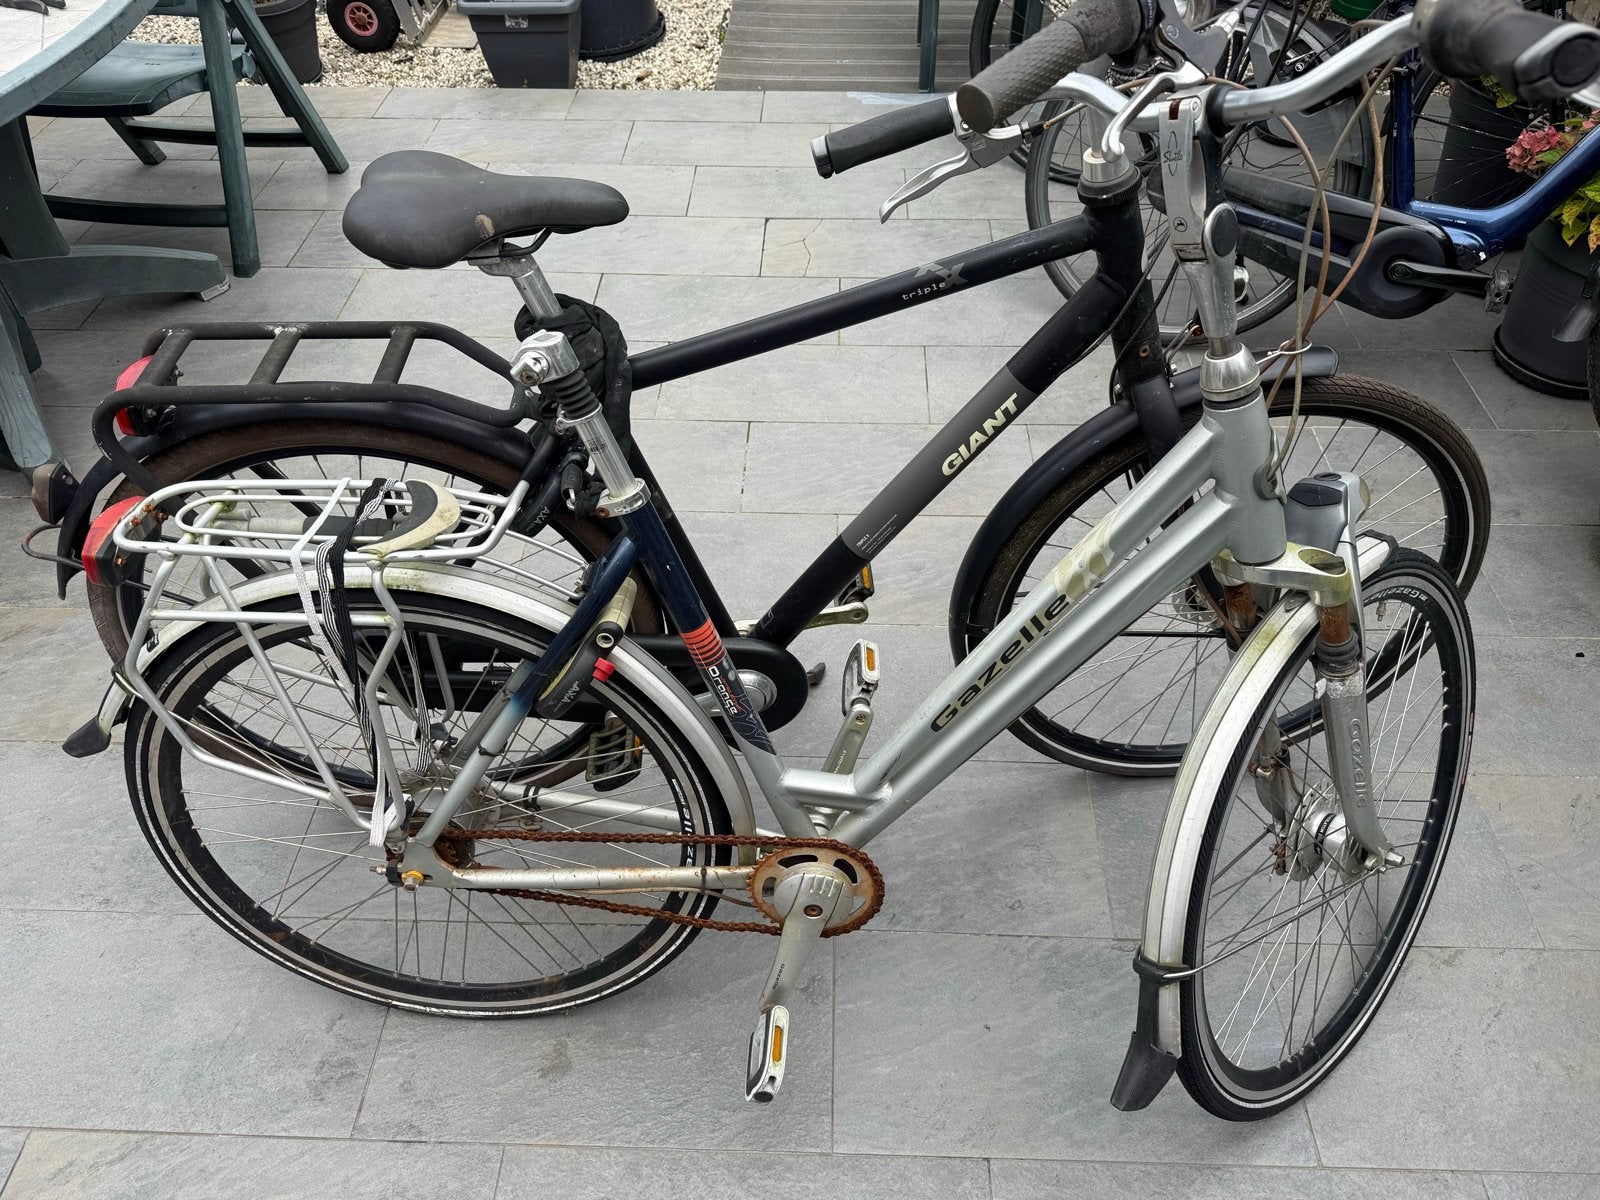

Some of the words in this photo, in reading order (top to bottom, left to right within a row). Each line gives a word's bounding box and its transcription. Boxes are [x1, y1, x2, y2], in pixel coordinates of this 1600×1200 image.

[902, 281, 946, 300] triple
[942, 392, 1018, 476] GIANT
[534, 506, 550, 525] AXA
[930, 593, 1070, 732] Gazelle
[561, 681, 580, 703] AXA
[708, 665, 738, 715] Orange
